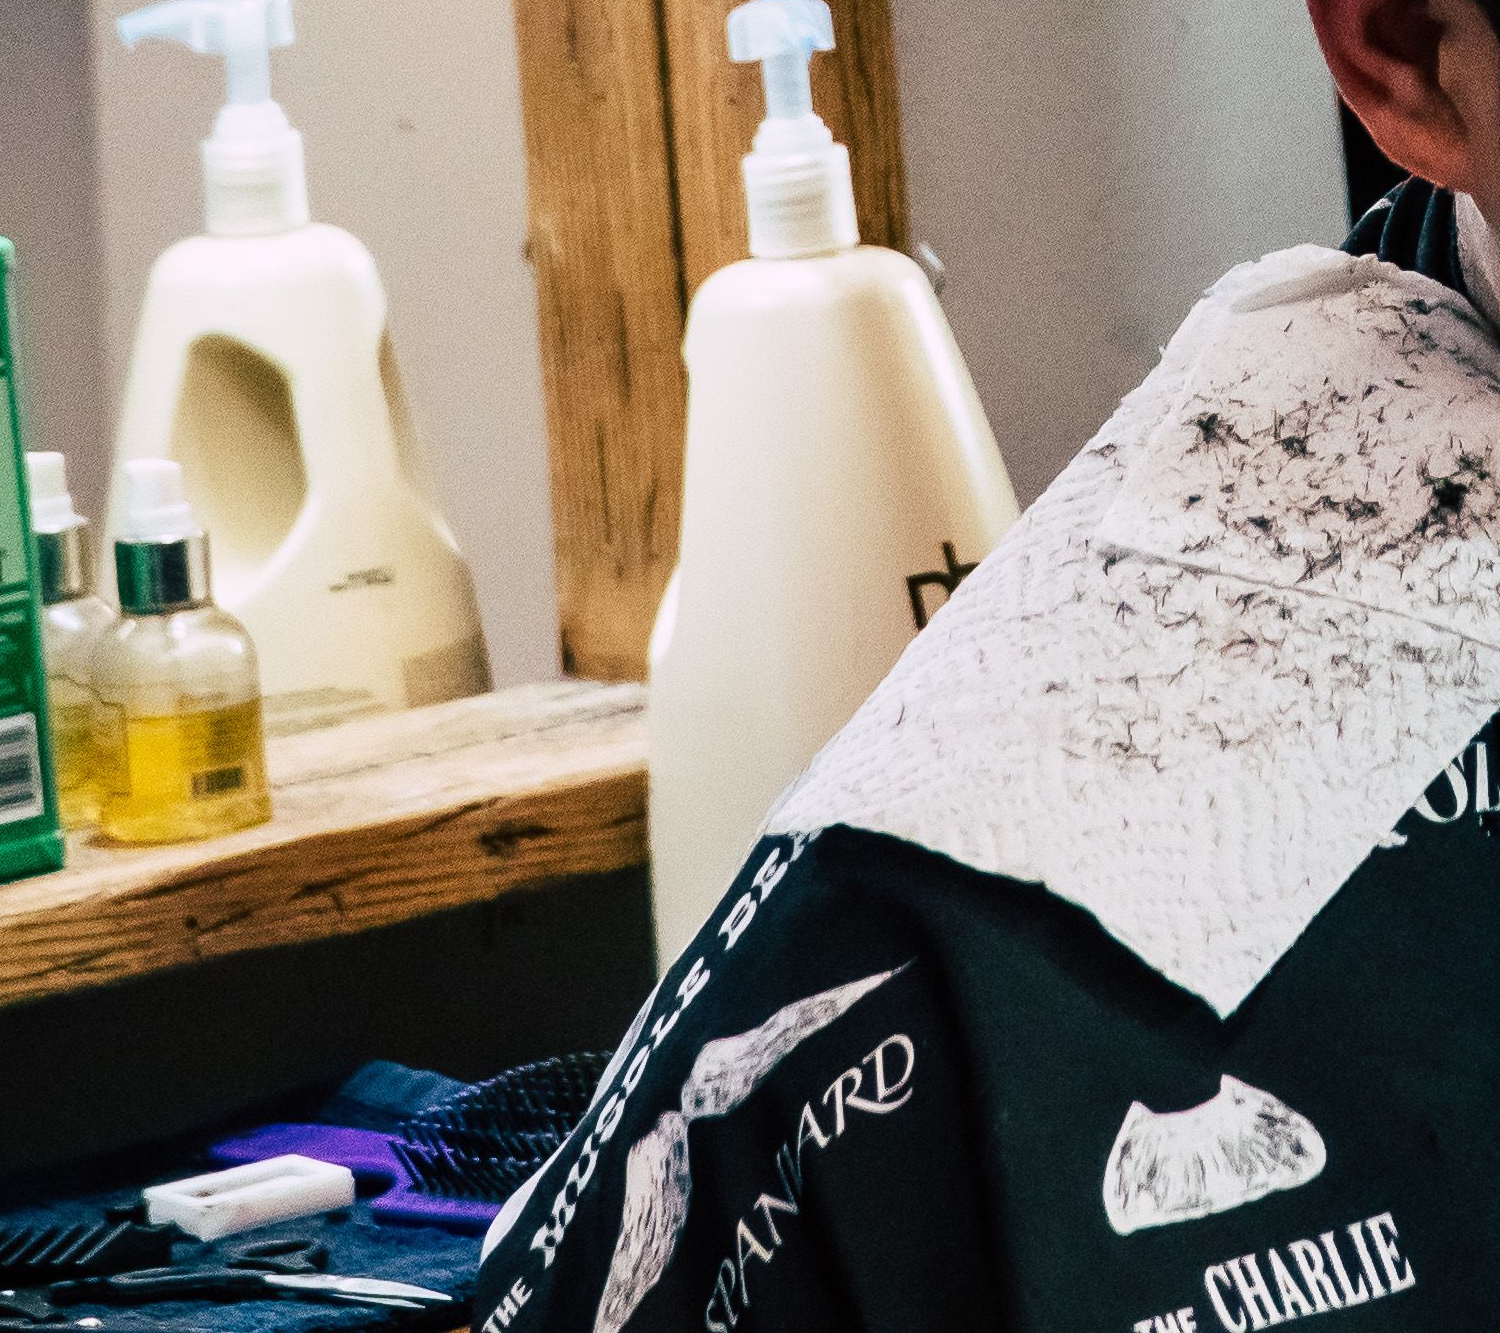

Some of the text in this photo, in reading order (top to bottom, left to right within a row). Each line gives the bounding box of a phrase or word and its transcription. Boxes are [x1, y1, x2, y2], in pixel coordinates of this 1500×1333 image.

[481, 1276, 533, 1333] THE
[531, 957, 711, 1269] MUSCLE
[1205, 1212, 1416, 1332] CHARLIE
